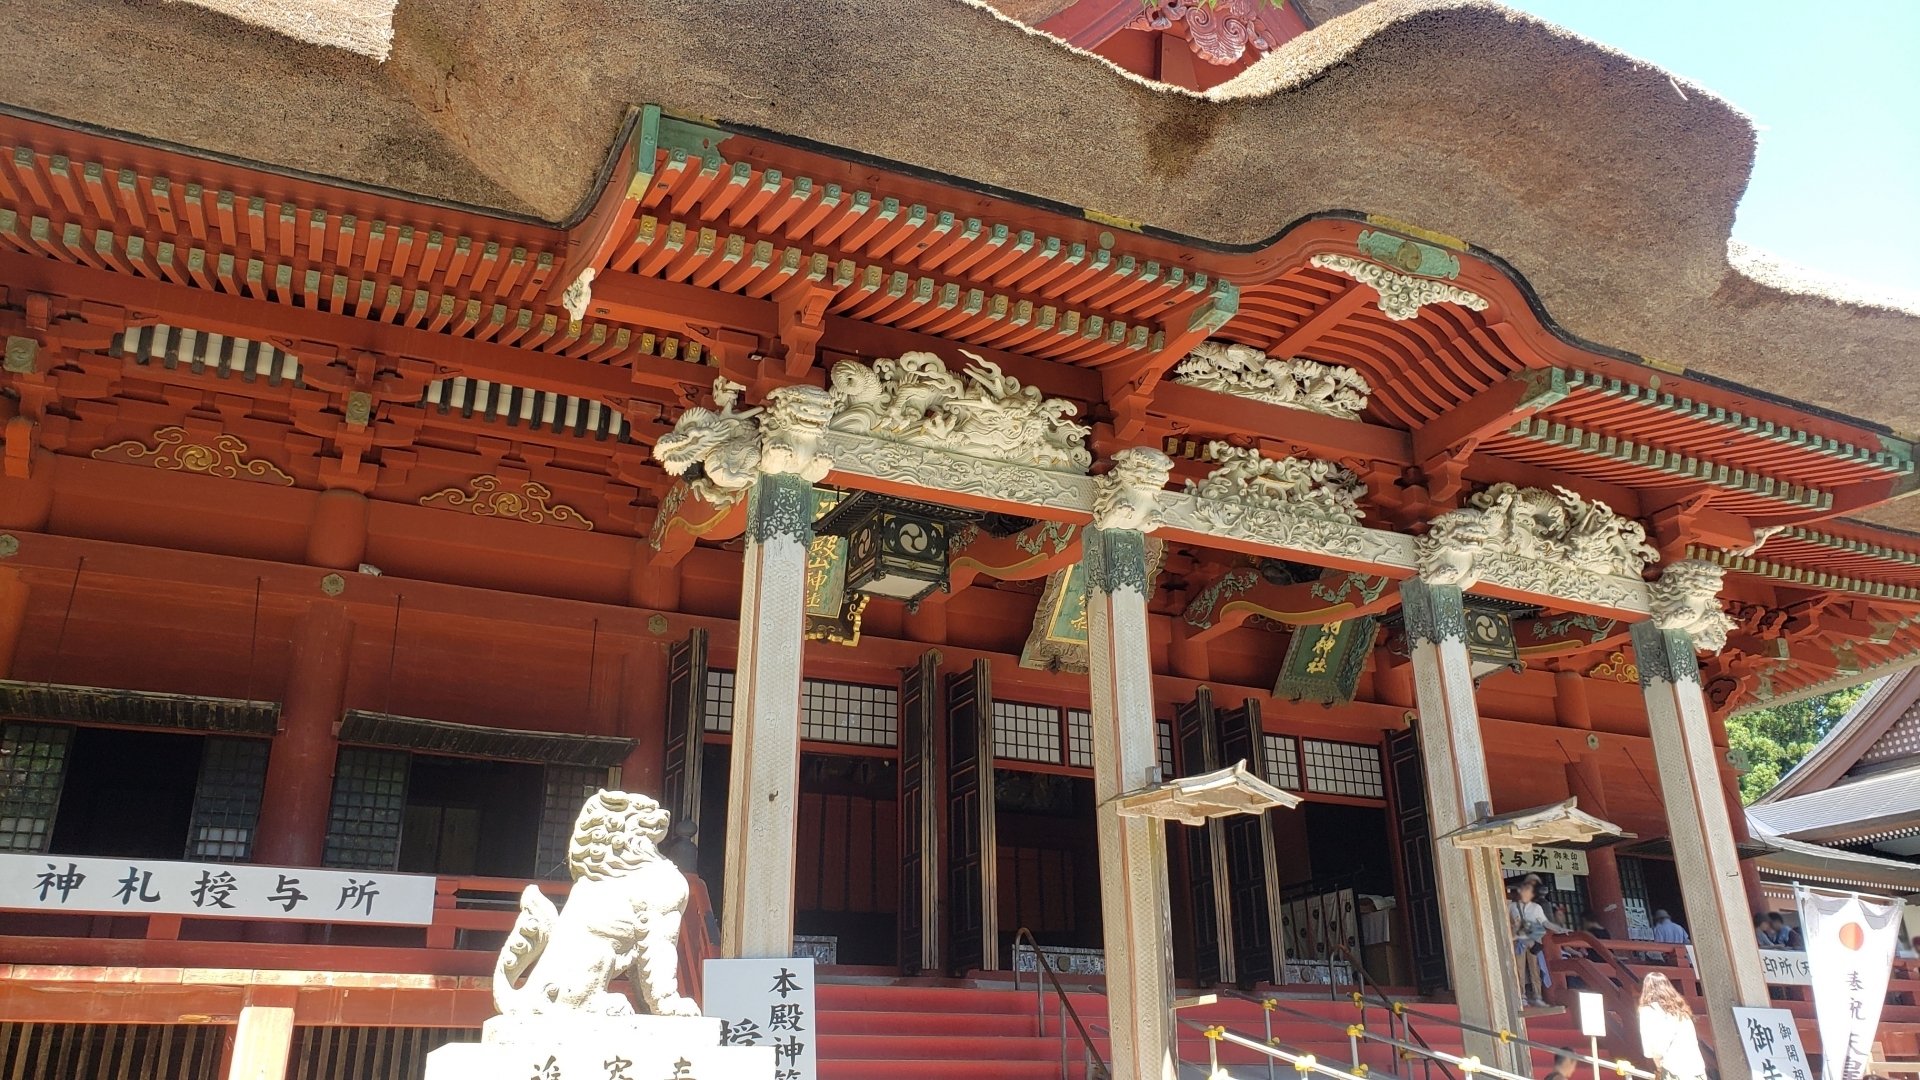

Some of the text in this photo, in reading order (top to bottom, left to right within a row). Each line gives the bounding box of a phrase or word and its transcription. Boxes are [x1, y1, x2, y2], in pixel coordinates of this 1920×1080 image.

[1500, 848, 1548, 869] 与所
[33, 863, 380, 916] 神札授与所
